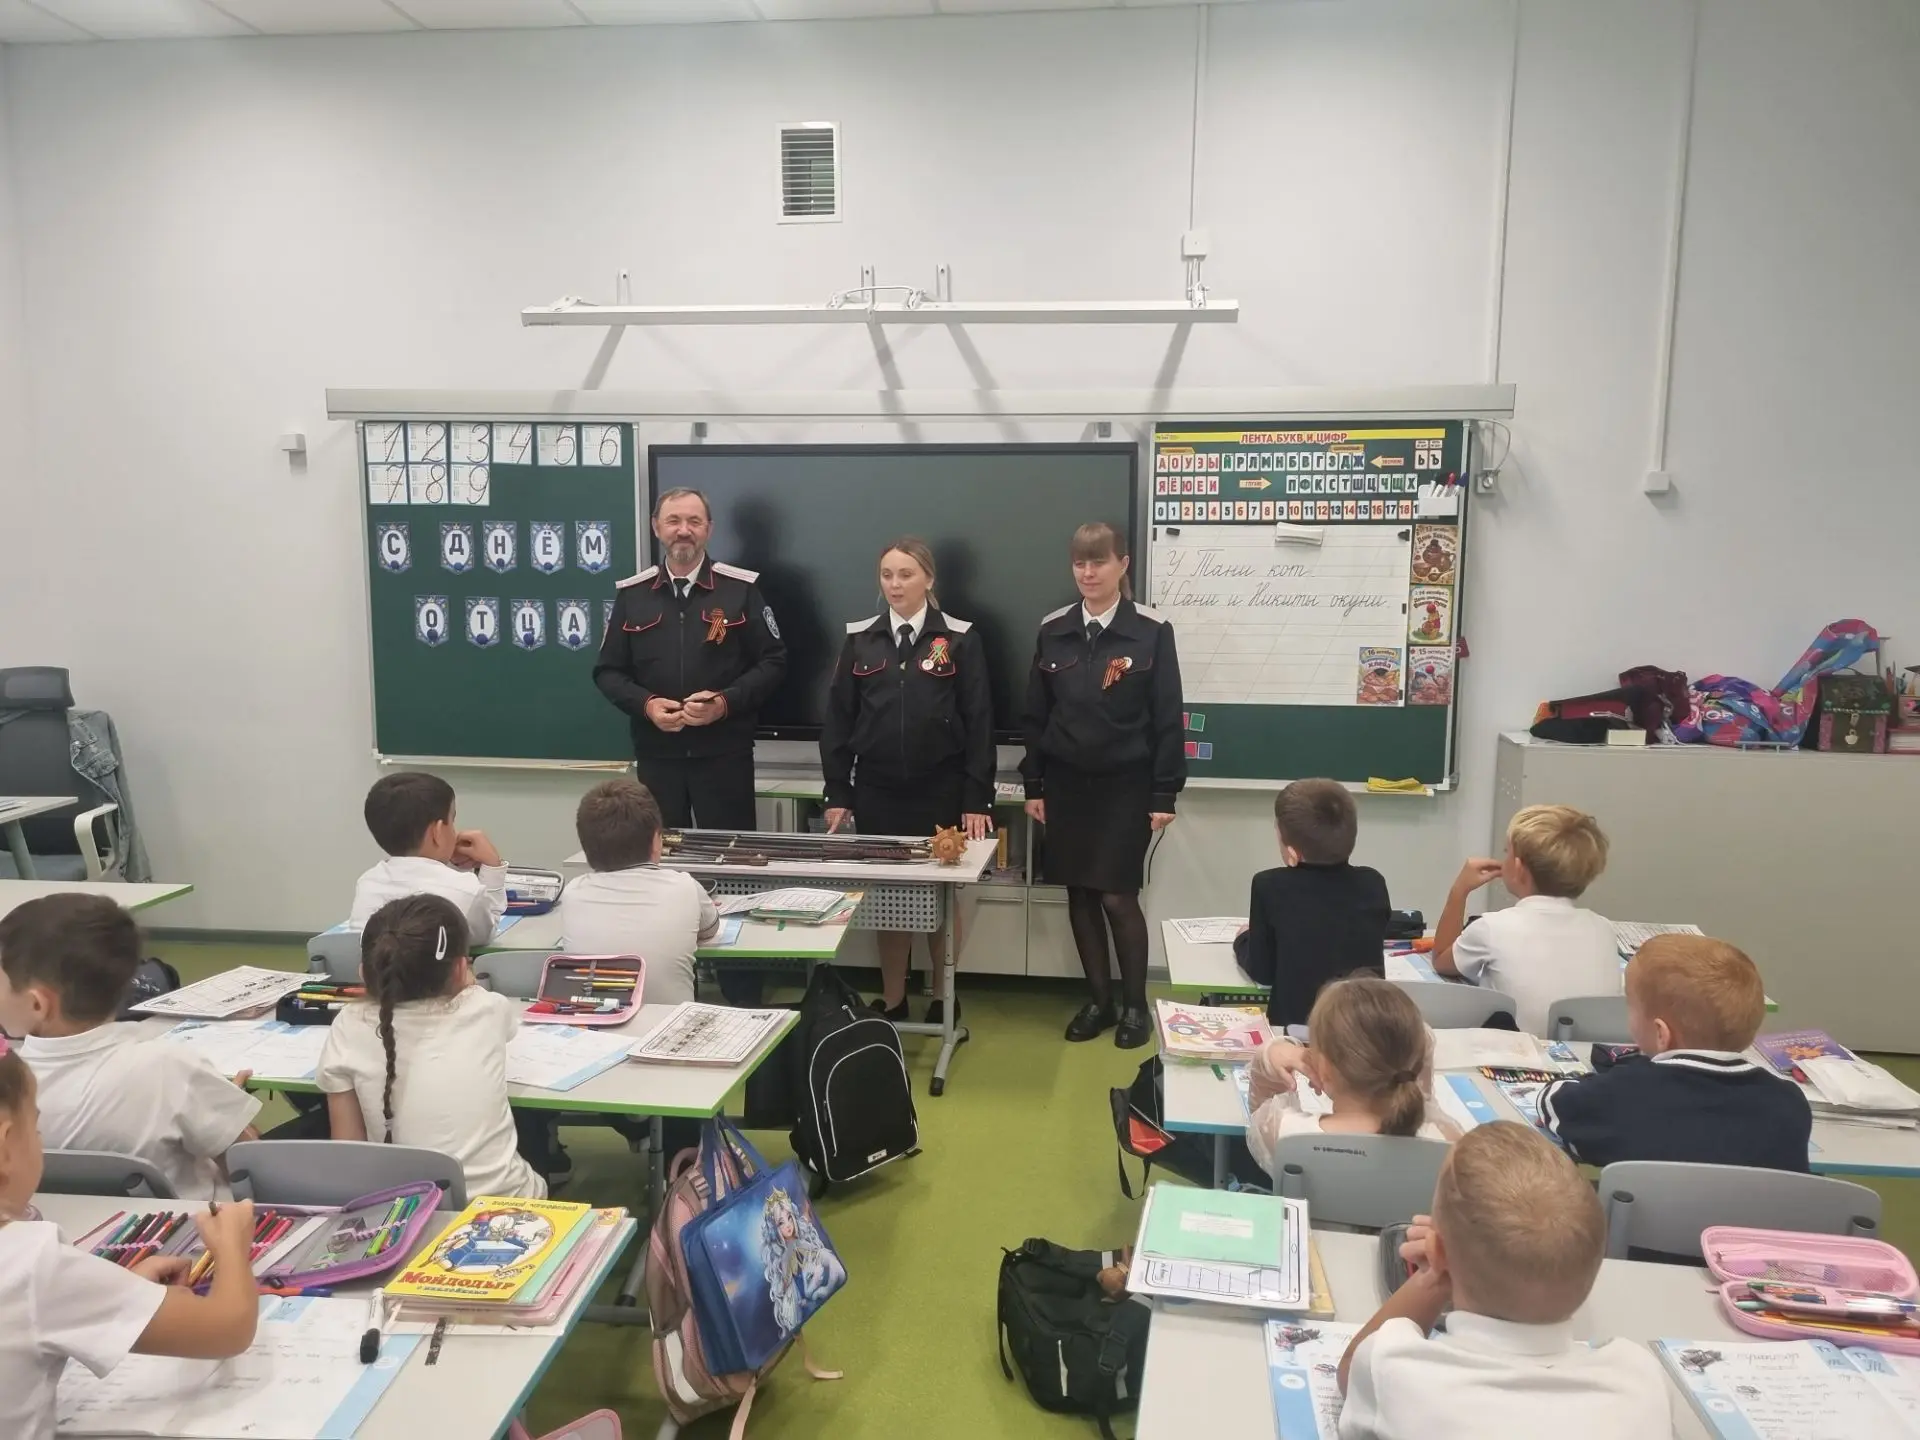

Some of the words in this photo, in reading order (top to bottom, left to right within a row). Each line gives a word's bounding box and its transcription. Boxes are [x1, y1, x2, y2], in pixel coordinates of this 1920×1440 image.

[384, 423, 402, 463] 1
[421, 422, 447, 463] 2
[466, 423, 490, 464] 3
[509, 423, 532, 464] 4
[553, 423, 576, 465] 5
[598, 424, 623, 466] 6
[1240, 433, 1274, 444] ЛЕНТА
[1276, 433, 1303, 443] БУКВ
[1306, 433, 1314, 443] И
[1316, 432, 1348, 444] ЦИФР
[386, 464, 406, 504] 7
[425, 464, 447, 504] 8
[466, 465, 490, 505] 9
[387, 533, 401, 556] С
[1166, 549, 1184, 576] У
[1191, 549, 1255, 577] Тани
[1157, 580, 1175, 606] У
[1227, 594, 1243, 607] и
[1248, 581, 1319, 607] Никиты
